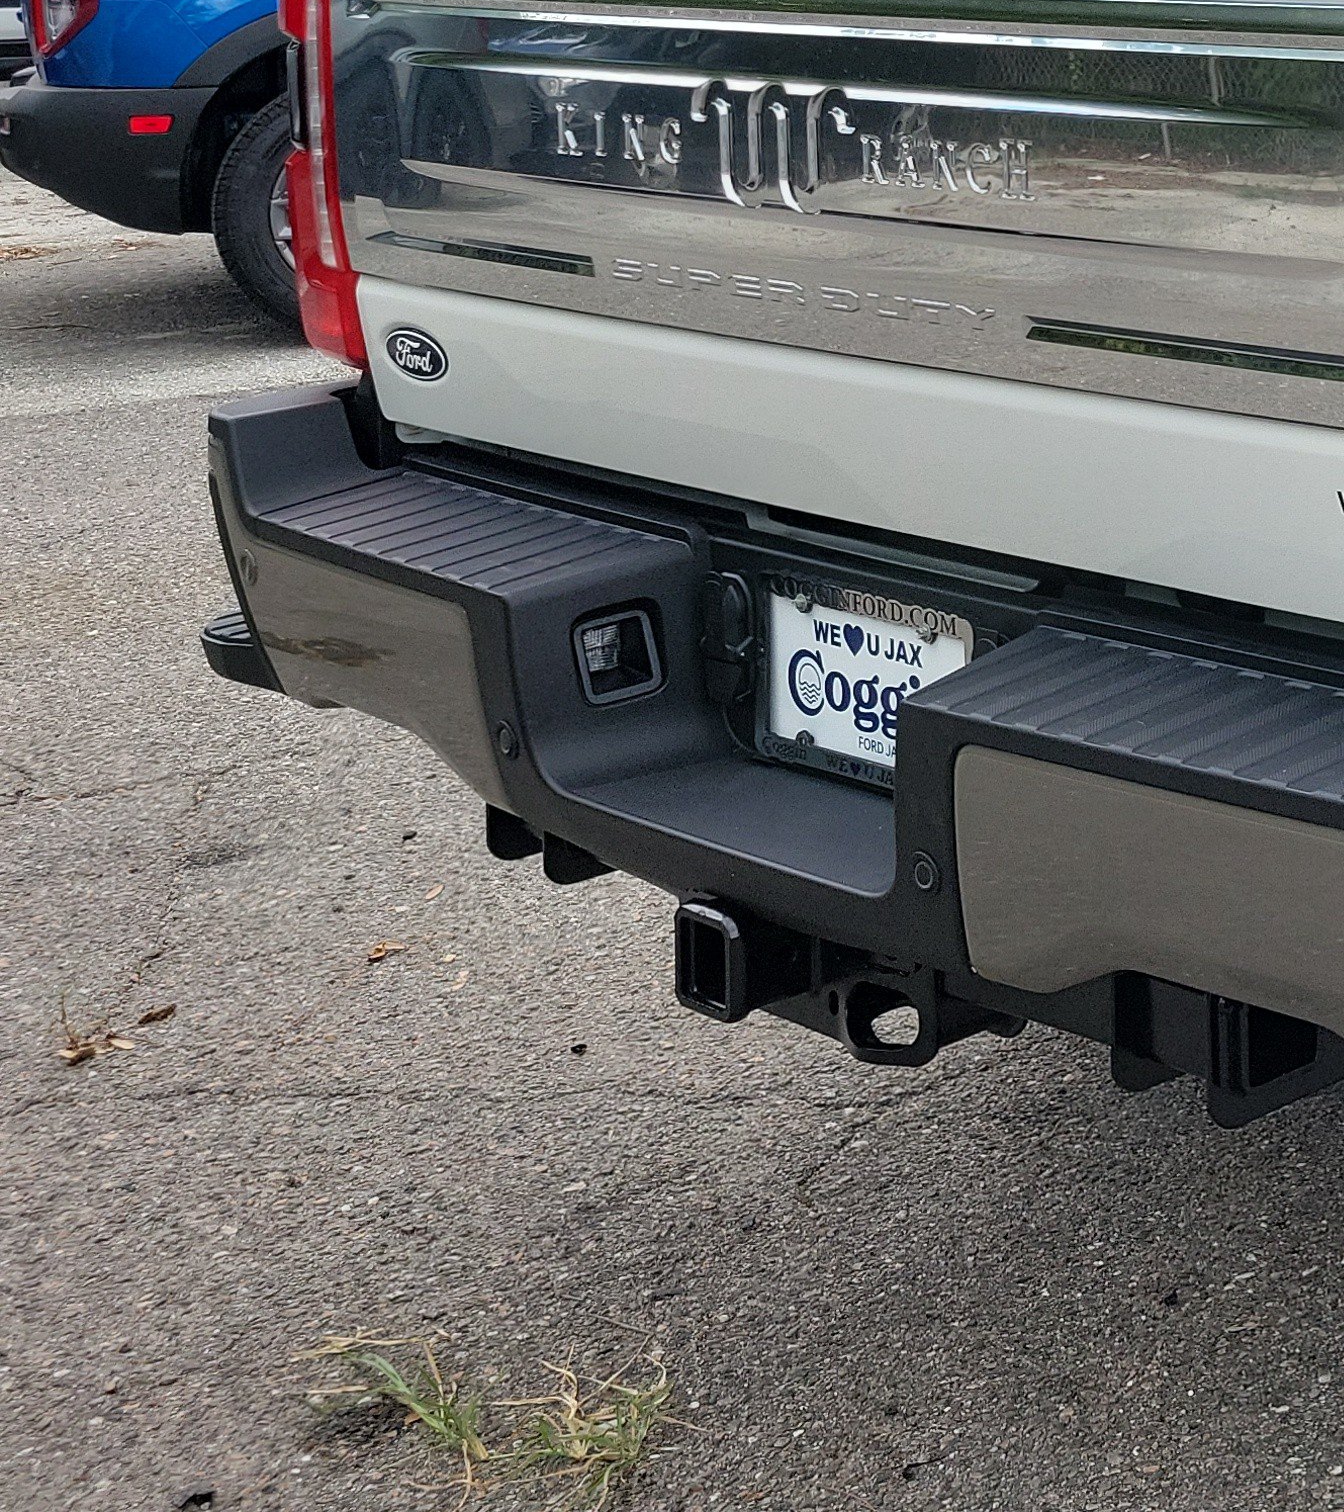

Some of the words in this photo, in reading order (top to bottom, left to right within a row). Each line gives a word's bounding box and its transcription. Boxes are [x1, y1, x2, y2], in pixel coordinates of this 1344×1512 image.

[555, 102, 682, 165] KING
[860, 133, 1036, 201] RANCH
[612, 259, 805, 307] SUPER
[820, 286, 996, 331] DUTY
[771, 574, 958, 636] COGGINFORD.COM
[813, 619, 842, 647] WE
[866, 632, 880, 656] U
[884, 638, 923, 669] JAX
[858, 736, 884, 754] FORD
